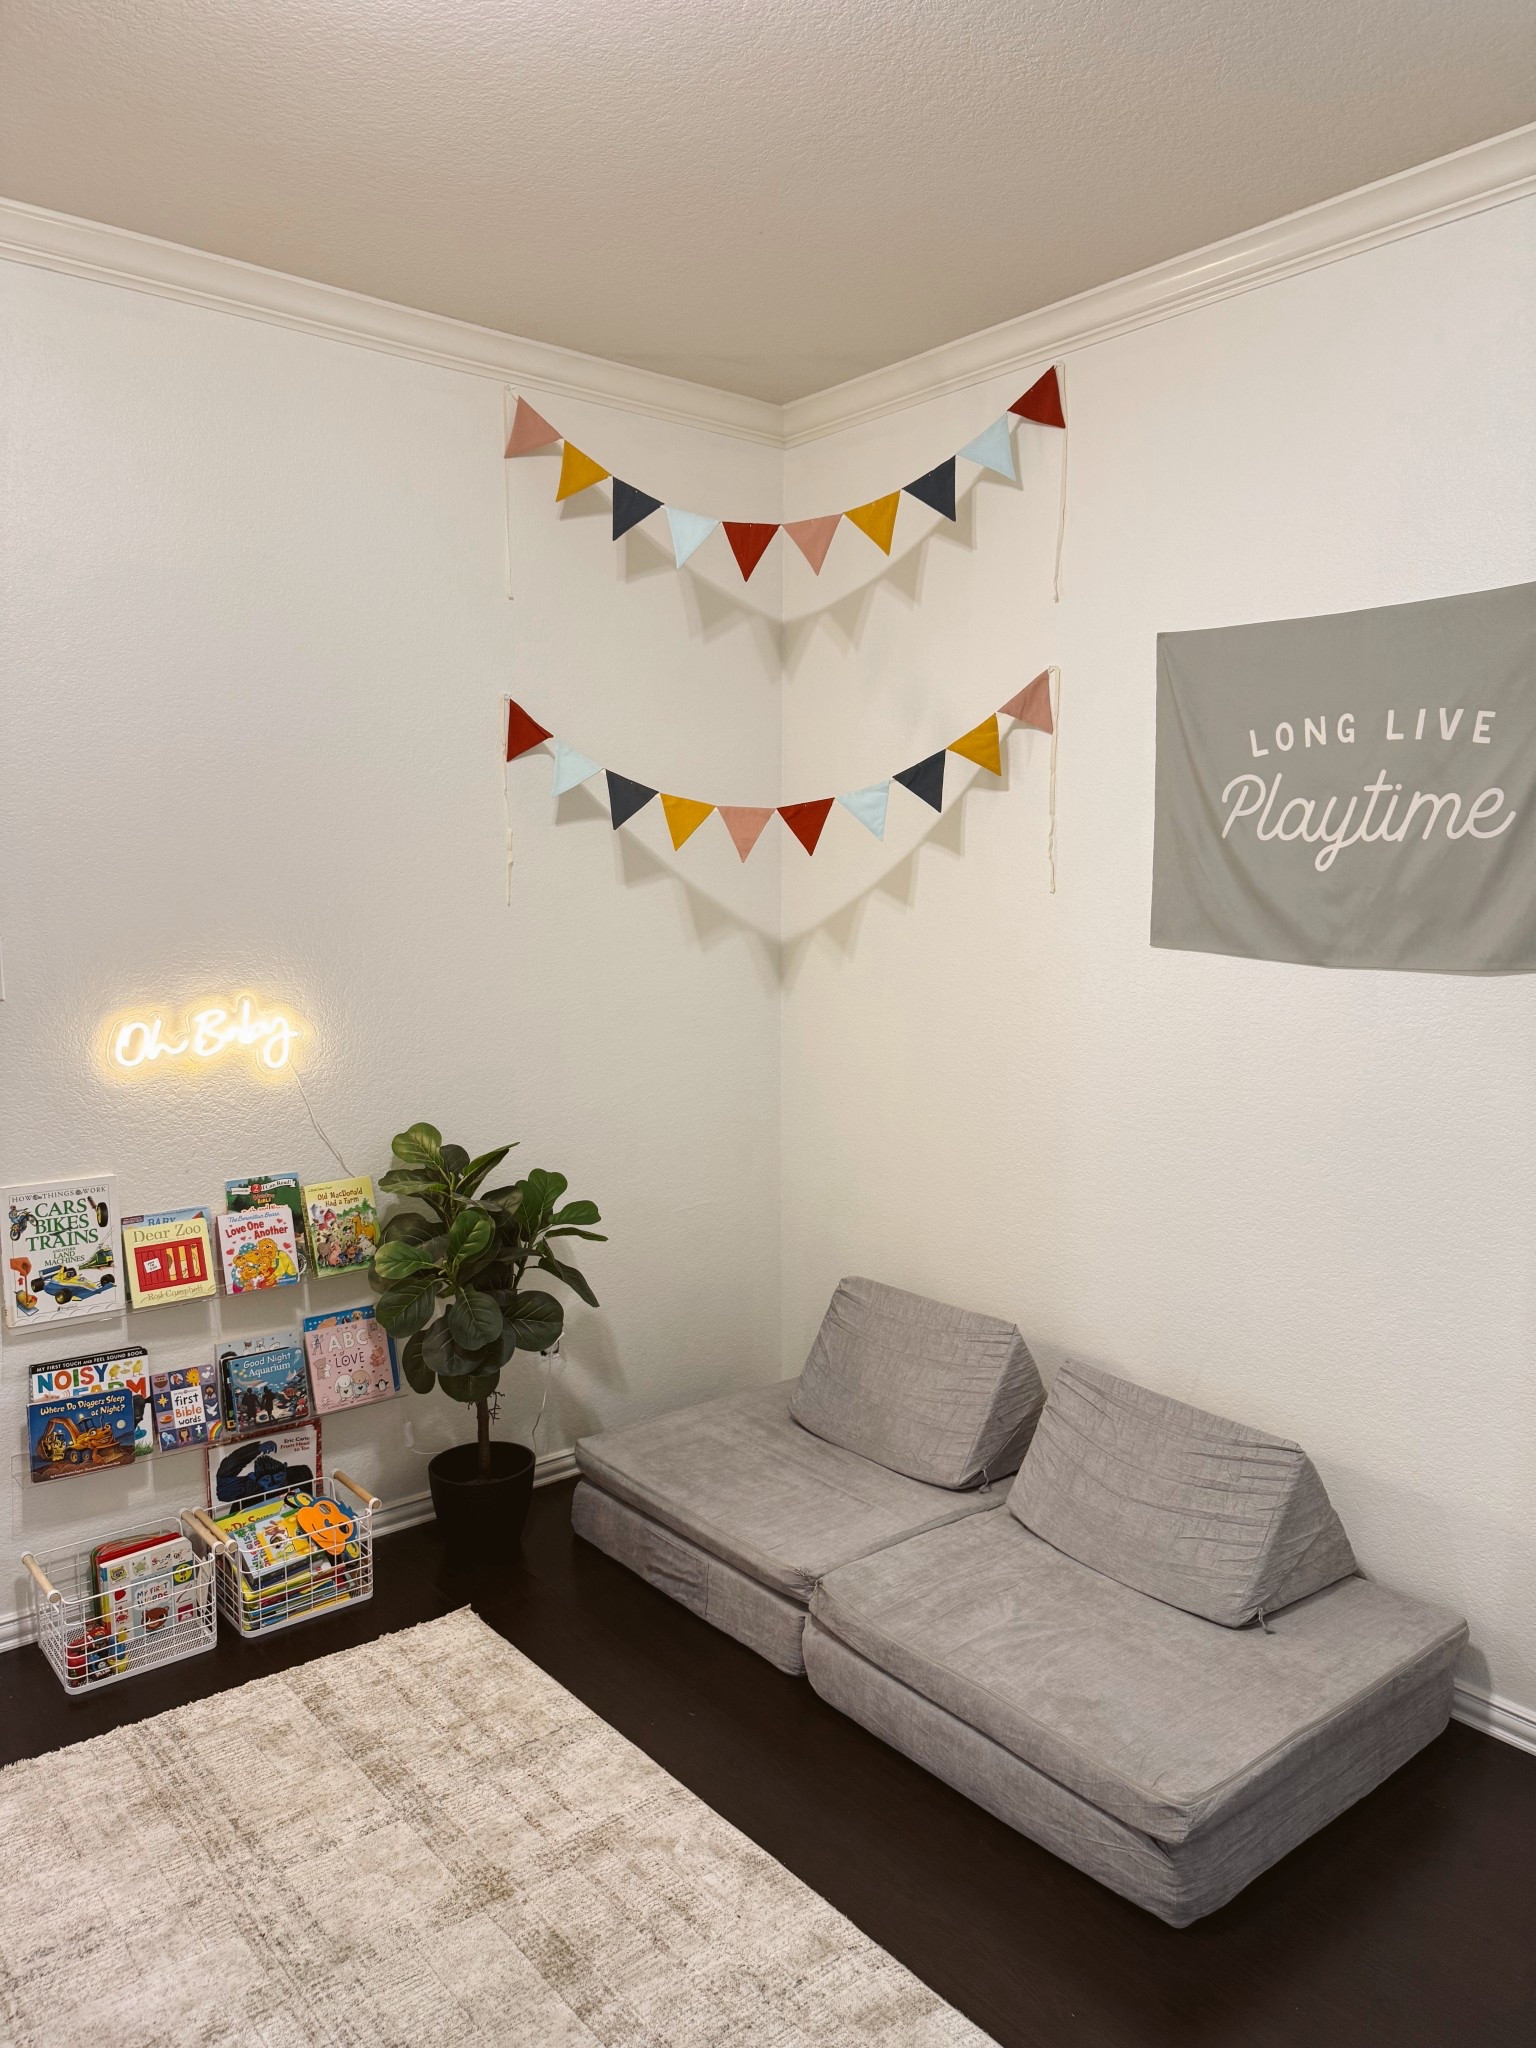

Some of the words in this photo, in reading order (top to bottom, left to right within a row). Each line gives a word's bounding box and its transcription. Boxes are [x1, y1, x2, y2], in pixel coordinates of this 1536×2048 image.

[1249, 712, 1355, 757] LONG
[1386, 707, 1496, 744] LIVE
[1221, 769, 1517, 872] Playtime
[114, 1018, 189, 1067] Oh
[192, 999, 300, 1069] Baby
[11, 1195, 32, 1203] HOW
[42, 1190, 75, 1199] THINGS
[82, 1186, 106, 1194] WORK
[317, 1192, 328, 1201] Old
[330, 1187, 363, 1199] MacDonald
[343, 1196, 360, 1204] Farm
[35, 1198, 87, 1217] CARS
[35, 1213, 90, 1234] BIKES
[225, 1225, 246, 1238] Love
[247, 1221, 265, 1231] One
[25, 1228, 99, 1252] TRAINS
[133, 1229, 170, 1242] Dear
[174, 1223, 202, 1236] Zoo
[254, 1225, 288, 1240] Another
[44, 1255, 85, 1266] MACHINES
[53, 1251, 76, 1259] LAND
[147, 1291, 163, 1300] Rod
[165, 1284, 203, 1298] Campbell
[328, 1328, 368, 1353] ABC
[62, 1360, 82, 1368] TOUCH
[106, 1353, 126, 1361] SOUND
[127, 1350, 143, 1358] BOOK
[243, 1357, 265, 1369] Good
[267, 1352, 291, 1364] Night
[335, 1351, 365, 1368] LOVE
[37, 1363, 108, 1393] NOISY
[248, 1362, 291, 1377] Aquarium
[40, 1406, 65, 1416] Where
[66, 1402, 77, 1411] Do
[77, 1399, 105, 1409] Diggers
[106, 1395, 126, 1404] Sleep
[174, 1392, 199, 1406] first
[90, 1409, 99, 1417] at
[100, 1404, 126, 1416] Night?
[175, 1405, 202, 1418] Bible
[178, 1415, 202, 1426] words
[137, 1590, 148, 1600] MY
